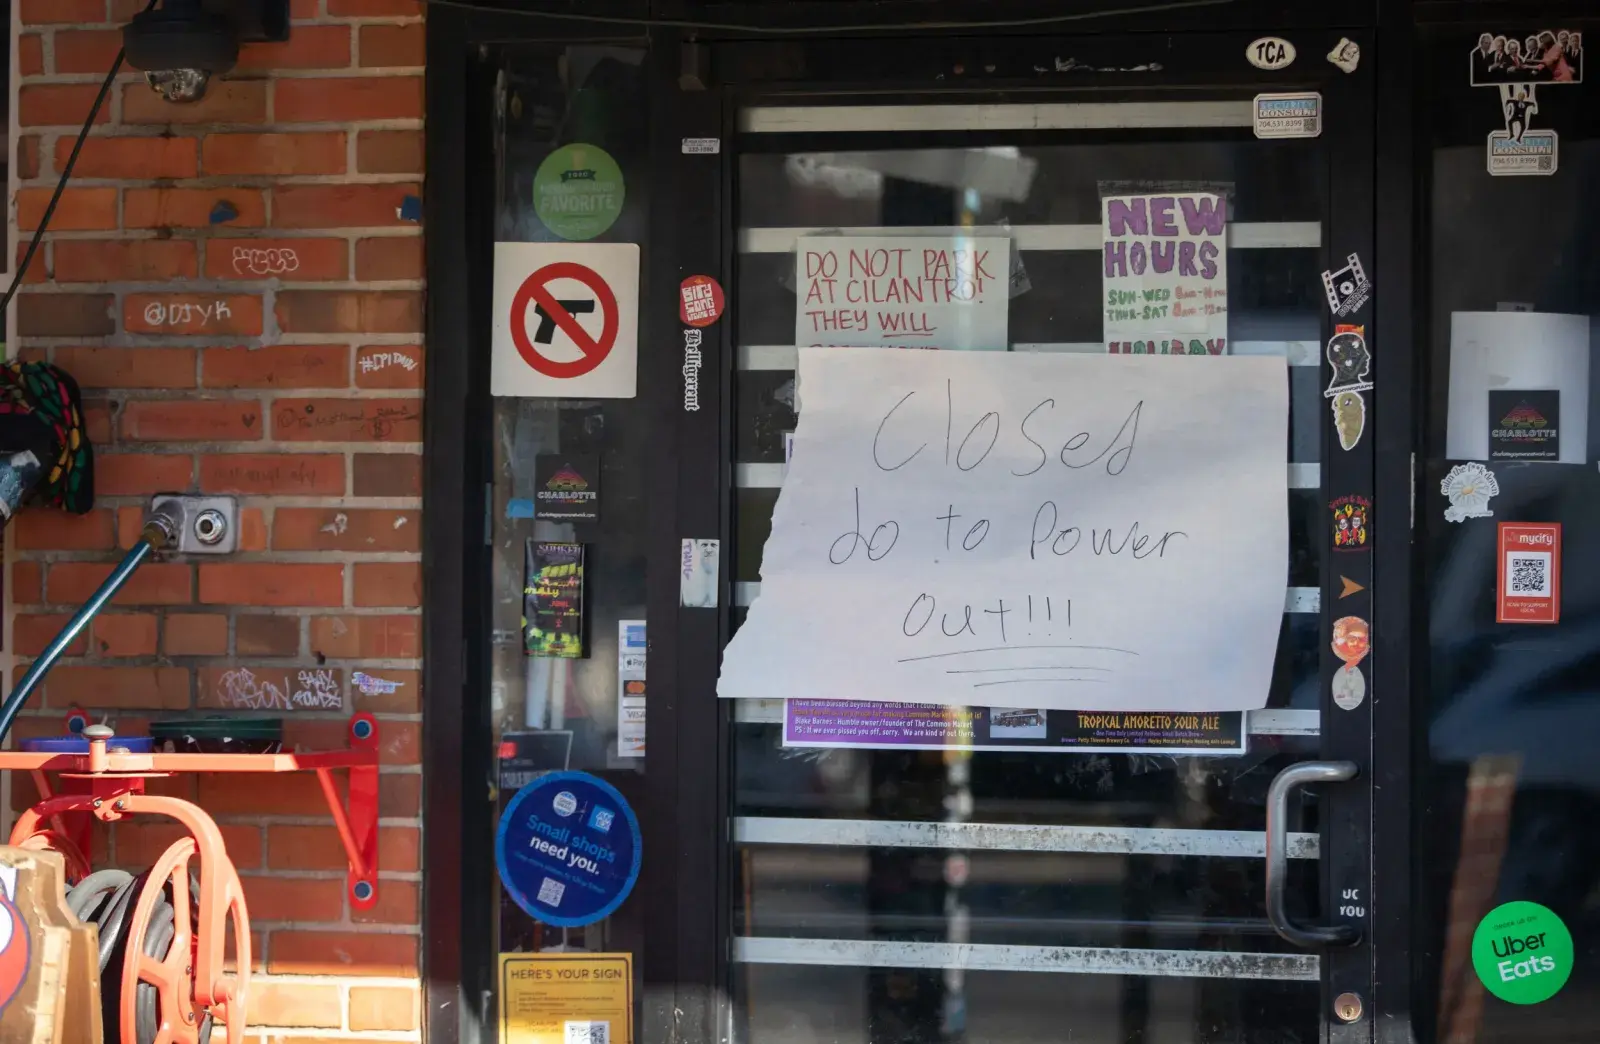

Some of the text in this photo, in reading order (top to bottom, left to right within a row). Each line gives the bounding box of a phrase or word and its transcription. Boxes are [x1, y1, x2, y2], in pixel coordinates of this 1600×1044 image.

[1256, 41, 1286, 64] TCA
[1261, 109, 1314, 117] CONSULT
[1262, 101, 1313, 109] SECURITY
[1258, 120, 1302, 128] 704.531.8399
[540, 195, 616, 213] FAVORITE
[1107, 197, 1226, 237] NEW
[806, 248, 996, 281] DO NOT PARK
[1104, 241, 1219, 280] HOURS
[805, 275, 984, 305] AT CILANTRO!
[805, 310, 937, 332] THEY WILL
[873, 378, 1143, 477] Closed
[1492, 429, 1557, 438] CHARLOTTE
[1441, 476, 1455, 494] calm
[1453, 466, 1467, 476] the
[1484, 472, 1498, 495] down
[537, 491, 597, 500] CHARLOTTE
[829, 487, 899, 565] do
[936, 504, 990, 551] to
[1519, 532, 1553, 546] mycity
[795, 717, 811, 725] Blake
[812, 717, 833, 726] Barnes
[837, 718, 860, 726] Humble
[861, 719, 906, 728] owner/founder
[915, 719, 925, 728] The
[926, 720, 950, 728] Common
[952, 720, 973, 729] Market
[1078, 715, 1220, 731] TROPICAL AMORETTO SOUR ALE
[837, 728, 857, 736] pissed
[858, 729, 869, 737] you
[882, 730, 900, 738] sorry.
[903, 729, 913, 737] We
[925, 729, 938, 737] kind
[958, 730, 976, 739] there.
[1106, 737, 1123, 745] Brewery
[526, 814, 616, 864] Small shops
[529, 836, 569, 861] need
[566, 852, 601, 876] you.
[1339, 905, 1365, 918] YOU
[1491, 932, 1546, 957] Uber
[511, 968, 622, 979] HERE'S YOUR SIGN
[1497, 955, 1556, 983] Eats
